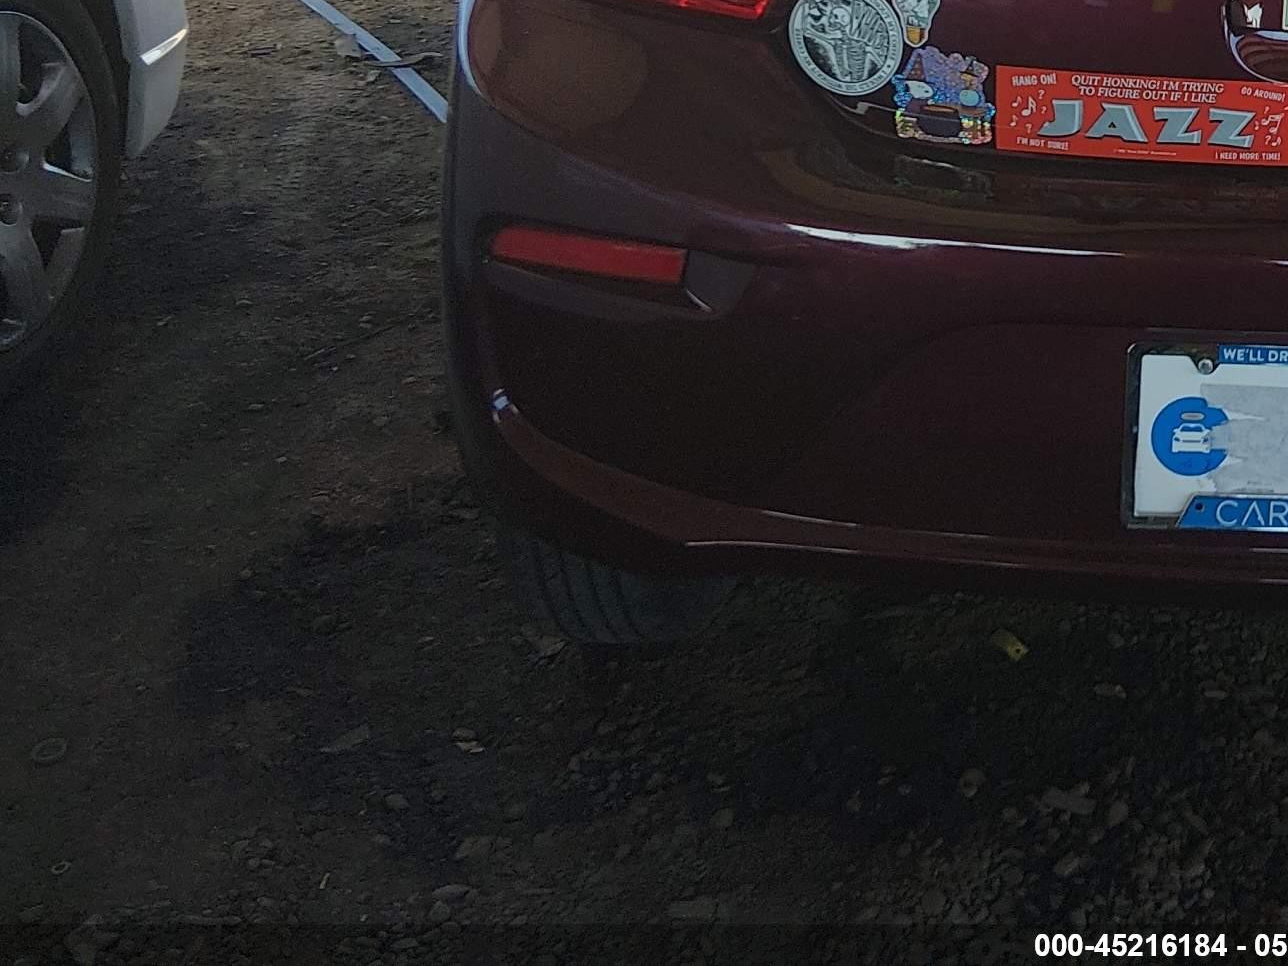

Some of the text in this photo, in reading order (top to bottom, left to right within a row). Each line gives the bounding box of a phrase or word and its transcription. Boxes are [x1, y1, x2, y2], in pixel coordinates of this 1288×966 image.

[1012, 72, 1057, 86] HANG ON!
[1071, 74, 1224, 93] QUIT HONKING! I'M TRYING
[1078, 86, 1217, 103] TO FIGURE OUT IF I LIKE
[1241, 86, 1286, 102] GO AROUND!
[1037, 99, 1258, 148] JAZZ
[1220, 152, 1238, 160] NEED
[1239, 152, 1260, 161] MORE
[1223, 348, 1264, 362] WE'LL
